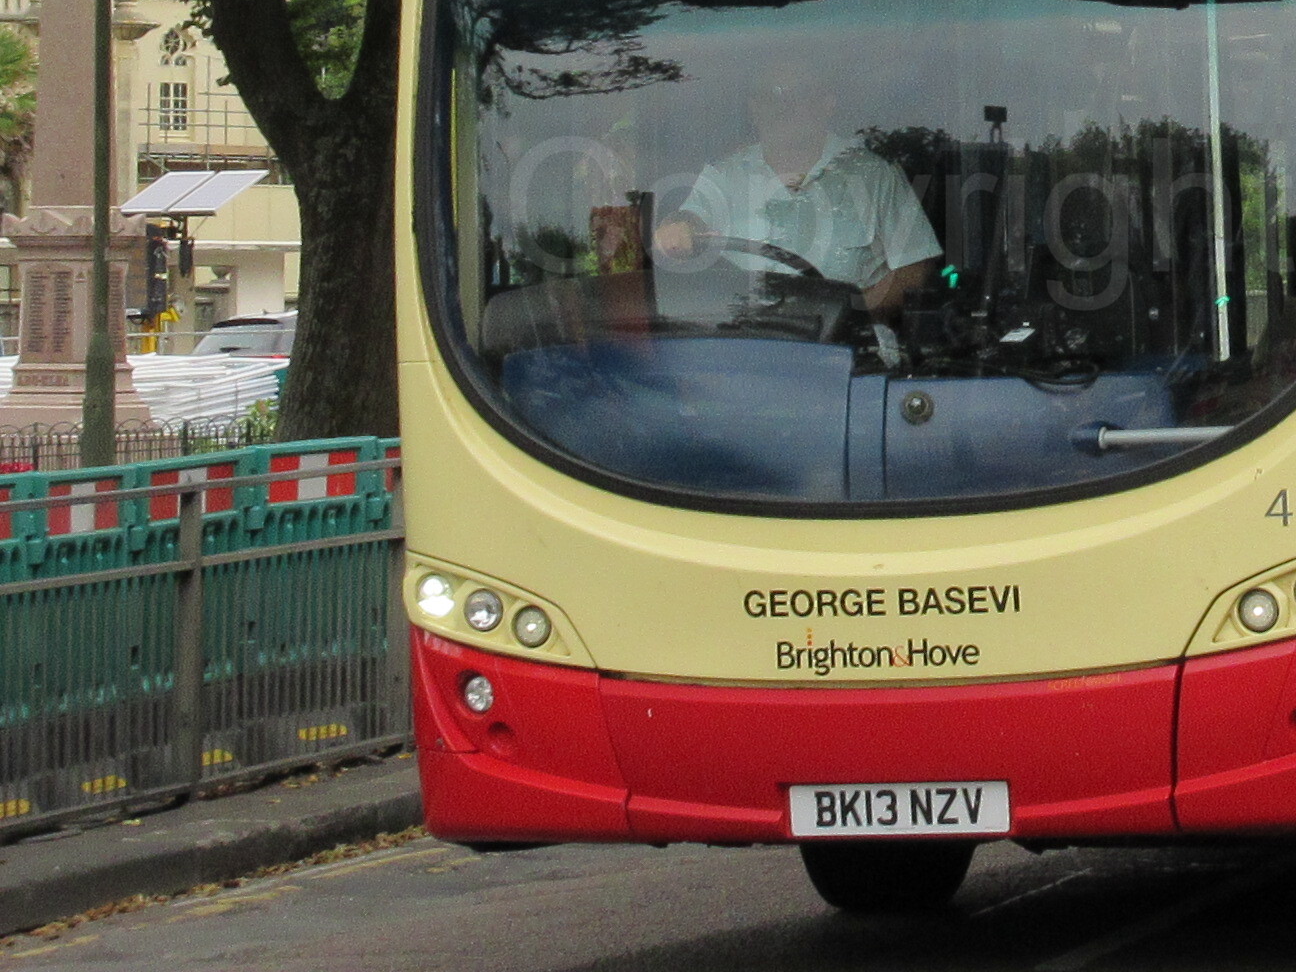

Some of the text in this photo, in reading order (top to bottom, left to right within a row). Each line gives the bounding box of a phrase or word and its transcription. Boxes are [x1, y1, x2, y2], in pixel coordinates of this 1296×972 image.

[743, 584, 1021, 618] GEORGE BASEVI
[813, 786, 983, 829] BK13 NZV
